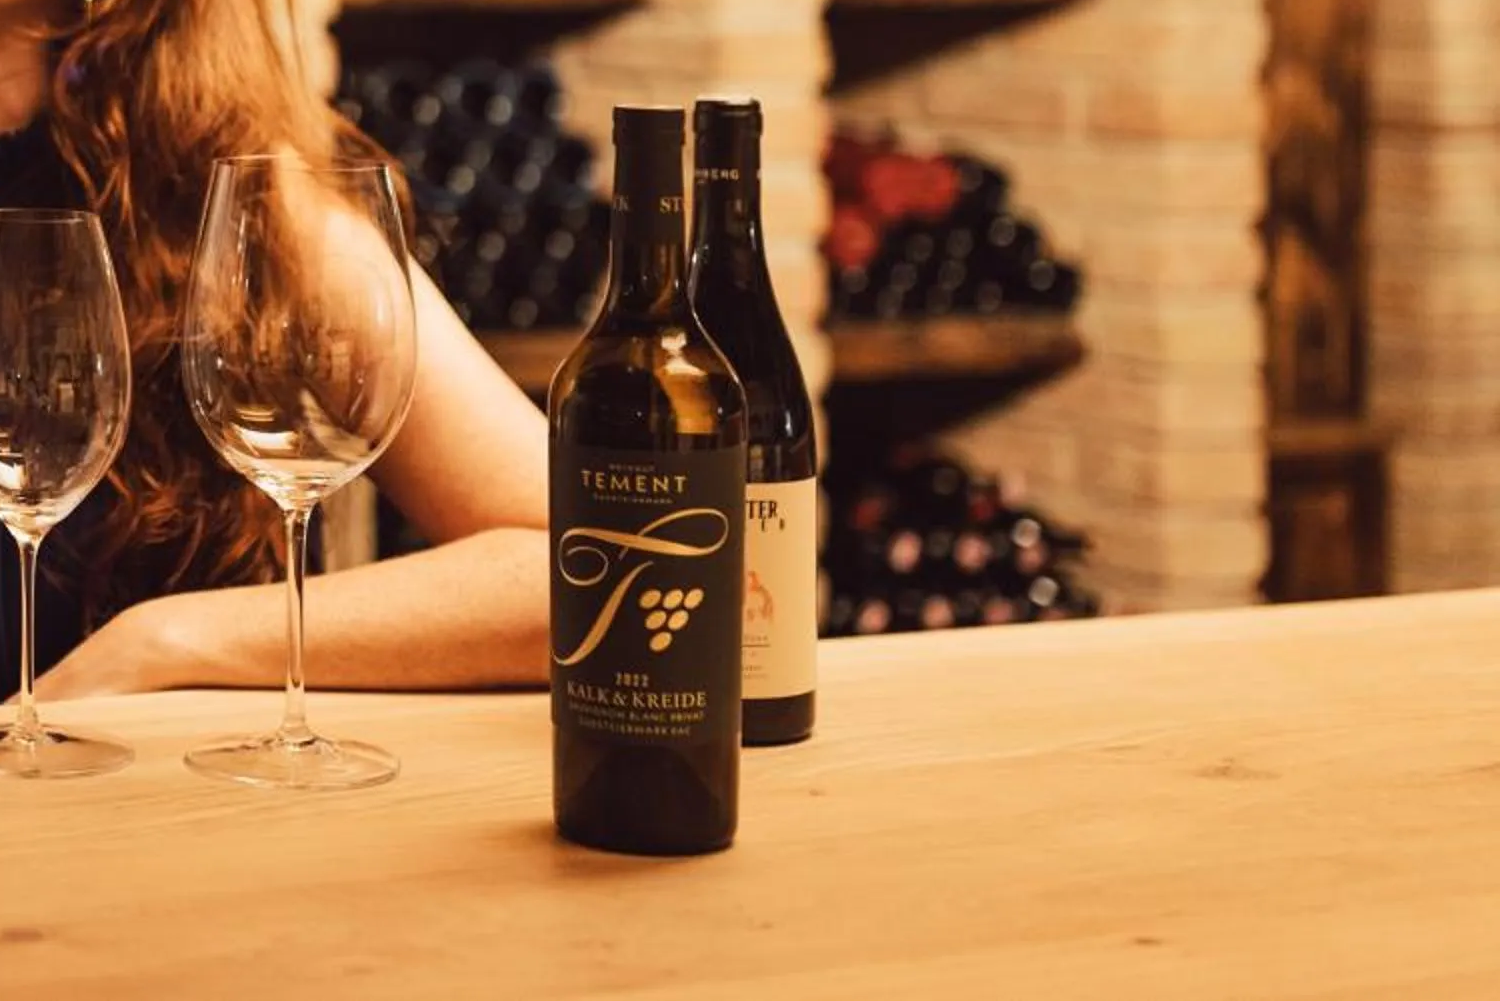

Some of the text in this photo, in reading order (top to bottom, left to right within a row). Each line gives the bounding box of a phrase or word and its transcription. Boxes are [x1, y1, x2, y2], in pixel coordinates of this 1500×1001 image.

[581, 469, 687, 494] TEMENT
[567, 681, 707, 710] KALK & KREIDE
